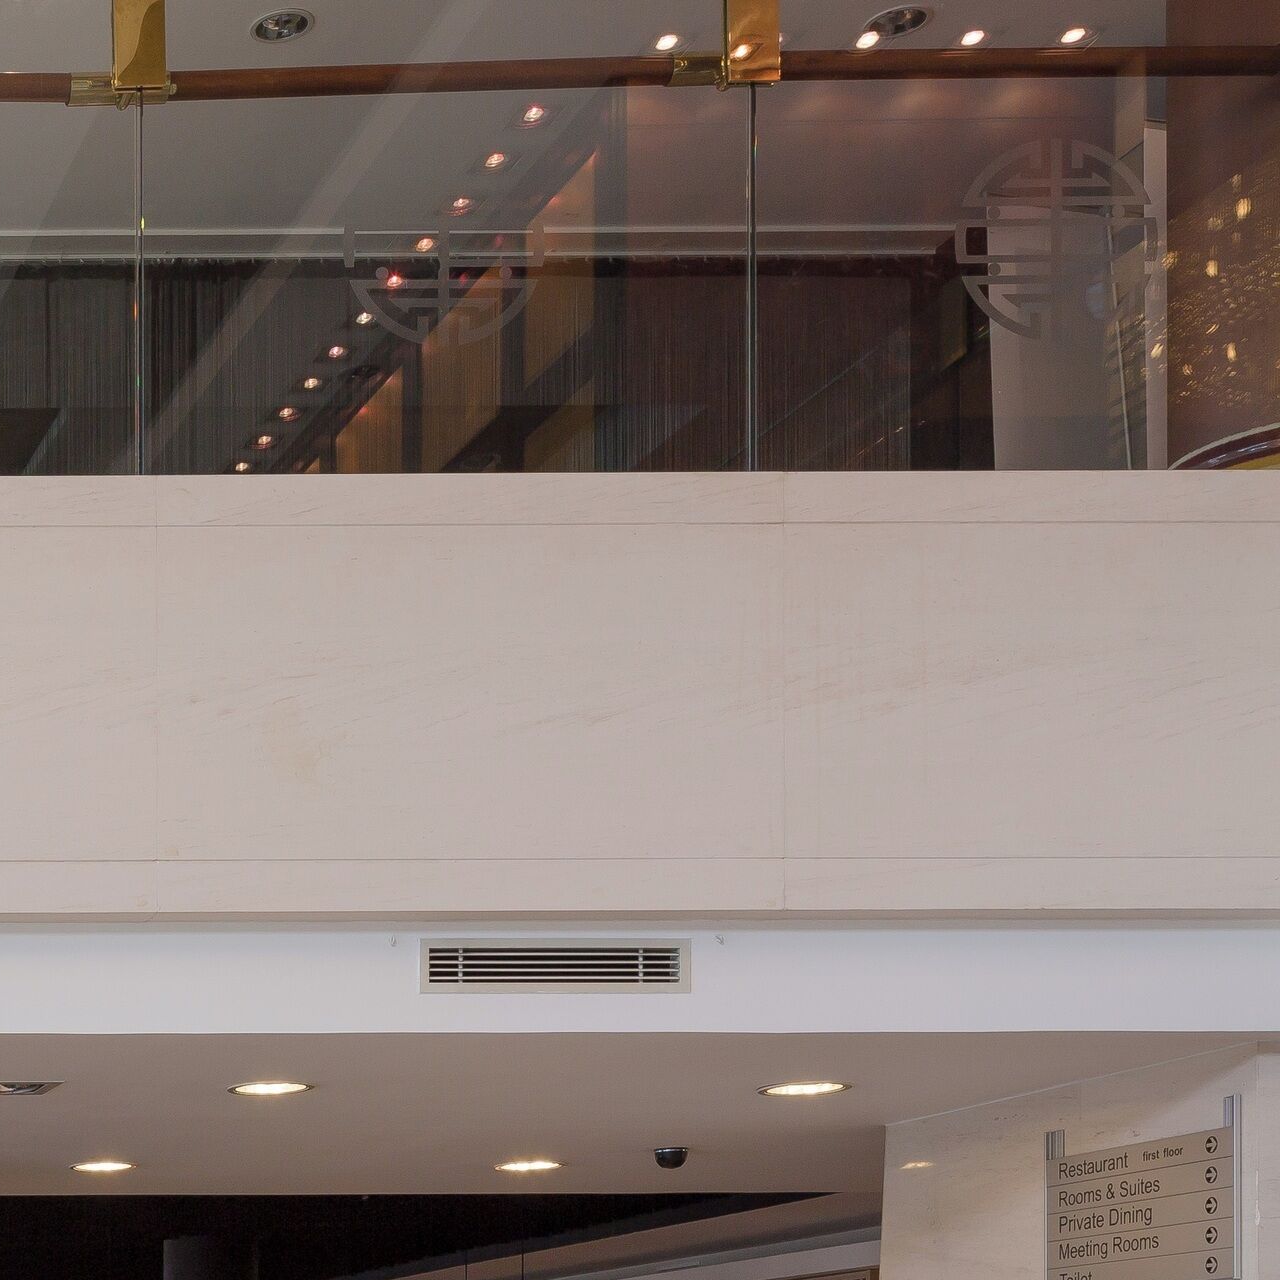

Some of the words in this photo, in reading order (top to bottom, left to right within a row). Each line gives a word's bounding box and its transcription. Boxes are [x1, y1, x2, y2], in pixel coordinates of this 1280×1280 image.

[1058, 1152, 1129, 1180] Restaurant
[1142, 1149, 1160, 1162] first
[1163, 1146, 1184, 1158] floor
[1058, 1190, 1102, 1207] Rooms
[1106, 1182, 1116, 1200] &
[1119, 1178, 1161, 1198] Suites
[1058, 1214, 1104, 1234] Private
[1109, 1206, 1153, 1226] Dining
[1058, 1239, 1108, 1261] Meeting
[1112, 1234, 1160, 1254] Rooms
